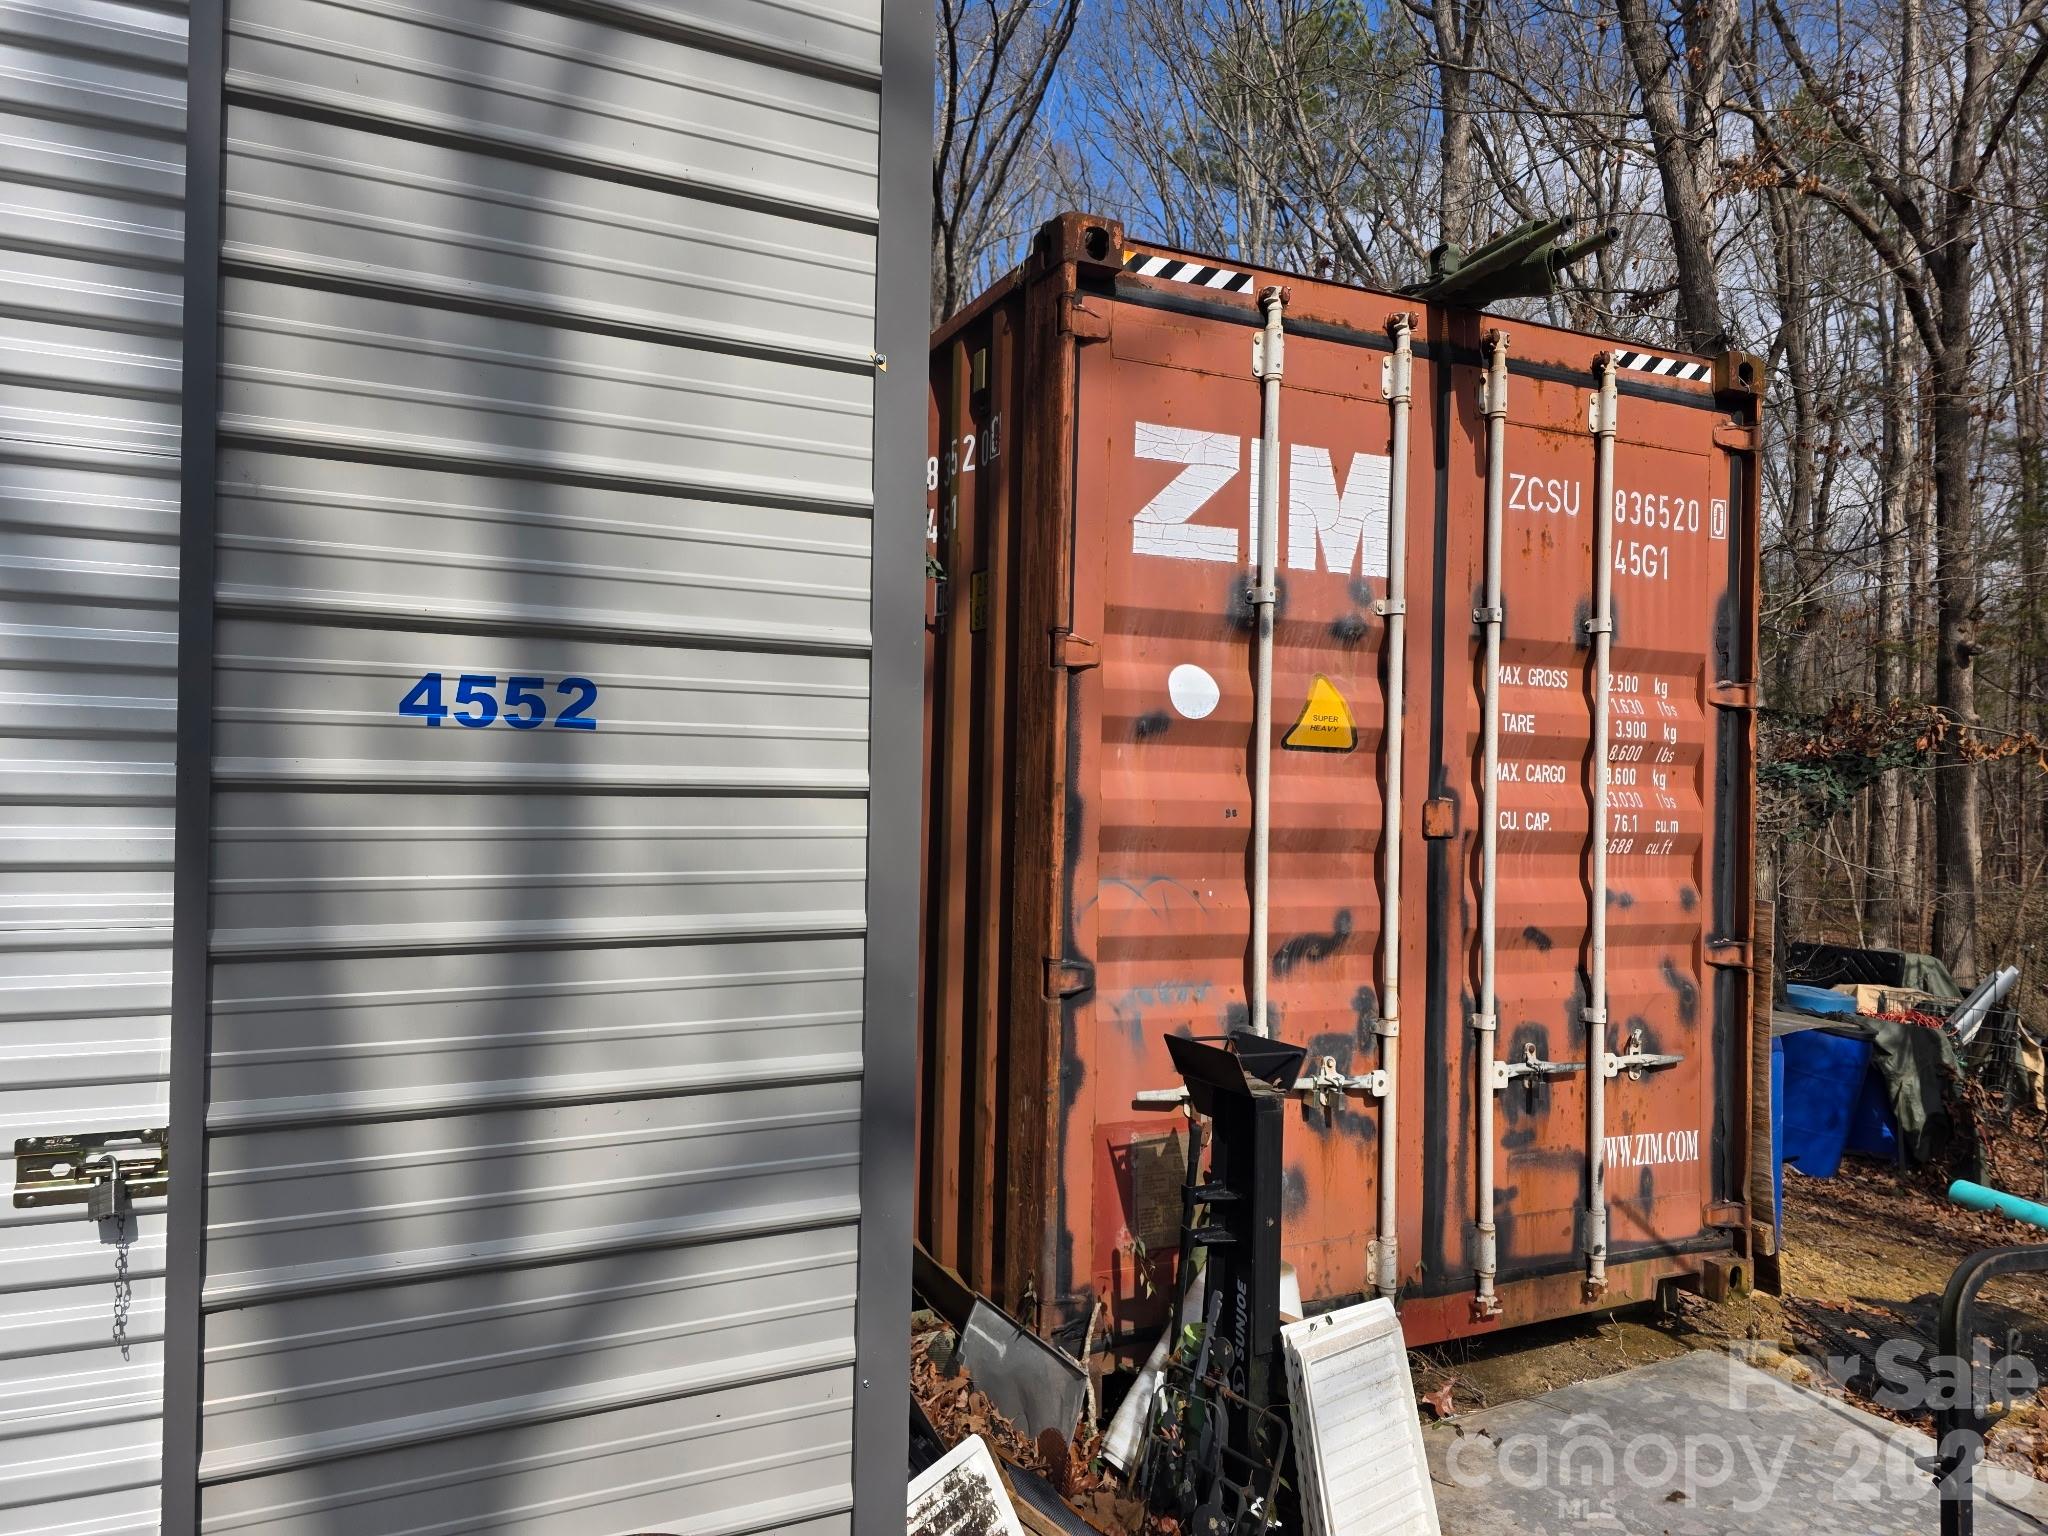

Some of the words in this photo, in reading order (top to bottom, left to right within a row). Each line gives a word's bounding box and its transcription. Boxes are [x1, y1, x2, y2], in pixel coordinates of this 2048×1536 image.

[1508, 472, 1580, 516] ZCSU
[1615, 489, 1699, 532] 836520
[1711, 499, 1727, 540] 0
[1614, 539, 1669, 580] 45G1
[1528, 669, 1568, 689] GROSS
[1654, 677, 1668, 699] kg
[398, 672, 598, 731] 4552
[1656, 700, 1678, 718] lbs
[1309, 724, 1340, 732] HEAVY
[1312, 714, 1339, 723] SUPER
[1501, 713, 1536, 734] TARE
[1663, 722, 1677, 745] kg
[1655, 746, 1675, 763] lbs
[1525, 764, 1566, 784] CARGO
[1652, 769, 1667, 791] kg
[1499, 811, 1520, 831] CU.
[1525, 812, 1552, 832] CAP.
[1614, 814, 1638, 833] 76.1
[1655, 819, 1679, 834] cu.m
[1603, 1129, 1699, 1169] WW.ZIM.COM
